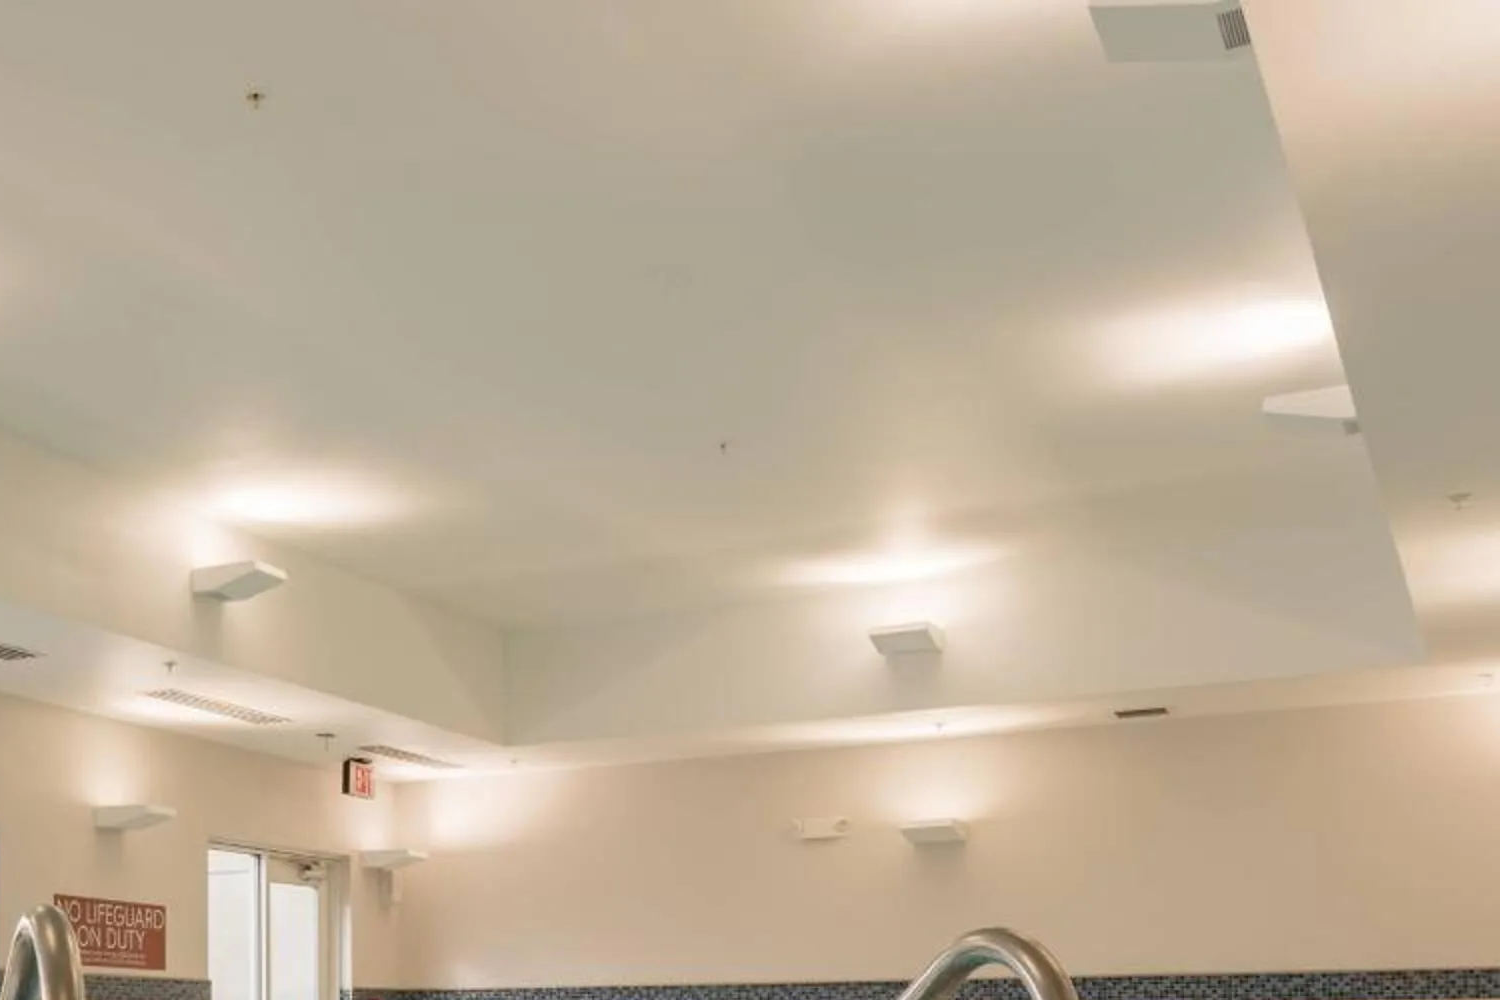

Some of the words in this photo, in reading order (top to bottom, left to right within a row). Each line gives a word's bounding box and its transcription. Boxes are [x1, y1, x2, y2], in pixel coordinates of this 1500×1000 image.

[85, 901, 164, 929] LIFEGUARD
[78, 925, 101, 948] ON
[106, 928, 145, 950] DUTY
